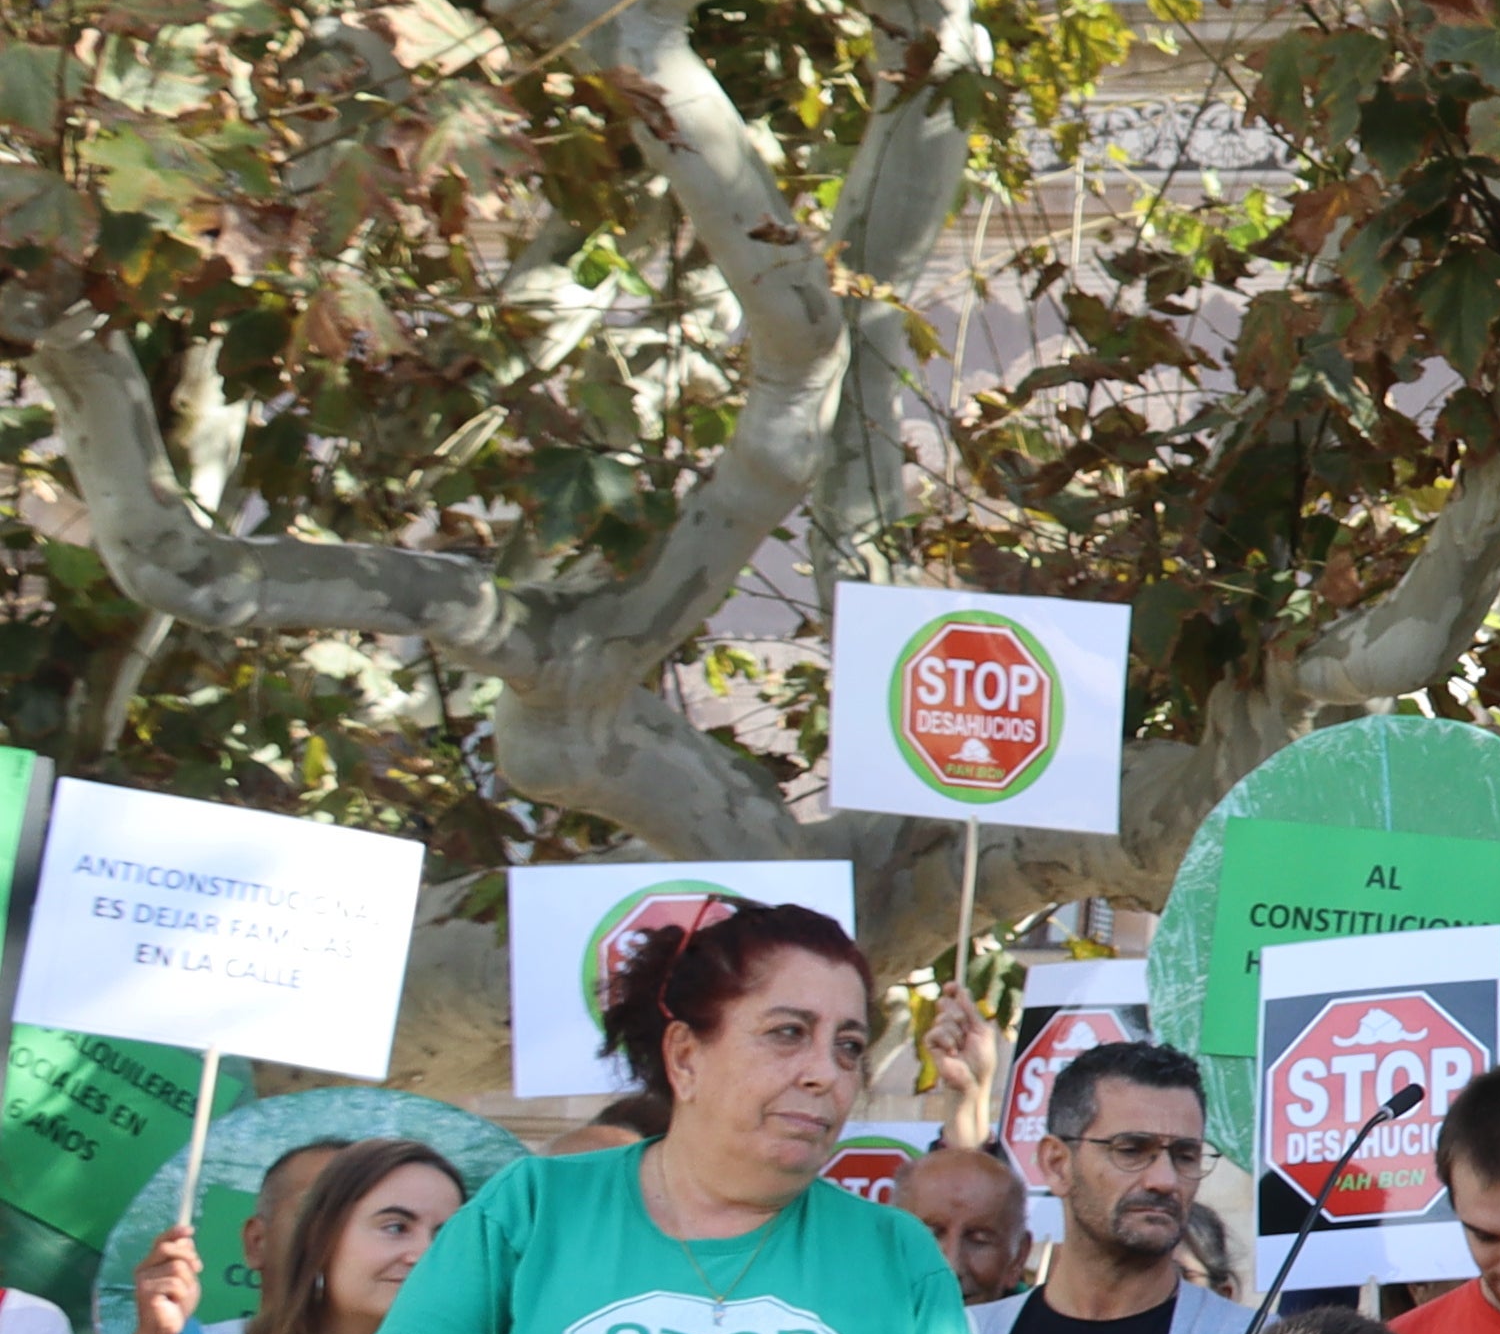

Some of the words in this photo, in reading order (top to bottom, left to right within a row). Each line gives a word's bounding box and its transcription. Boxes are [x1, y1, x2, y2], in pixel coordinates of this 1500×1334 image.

[916, 656, 1038, 712] STOP
[916, 710, 1036, 743] DESAHUCIOS
[1365, 865, 1402, 891] AL
[92, 895, 125, 920] ES
[134, 903, 220, 937] DEJAR
[134, 942, 170, 968] EN
[182, 948, 213, 972] LA
[1285, 1046, 1473, 1127] STOP
[110, 1104, 148, 1138] EN
[1377, 1168, 1426, 1189] BCN
